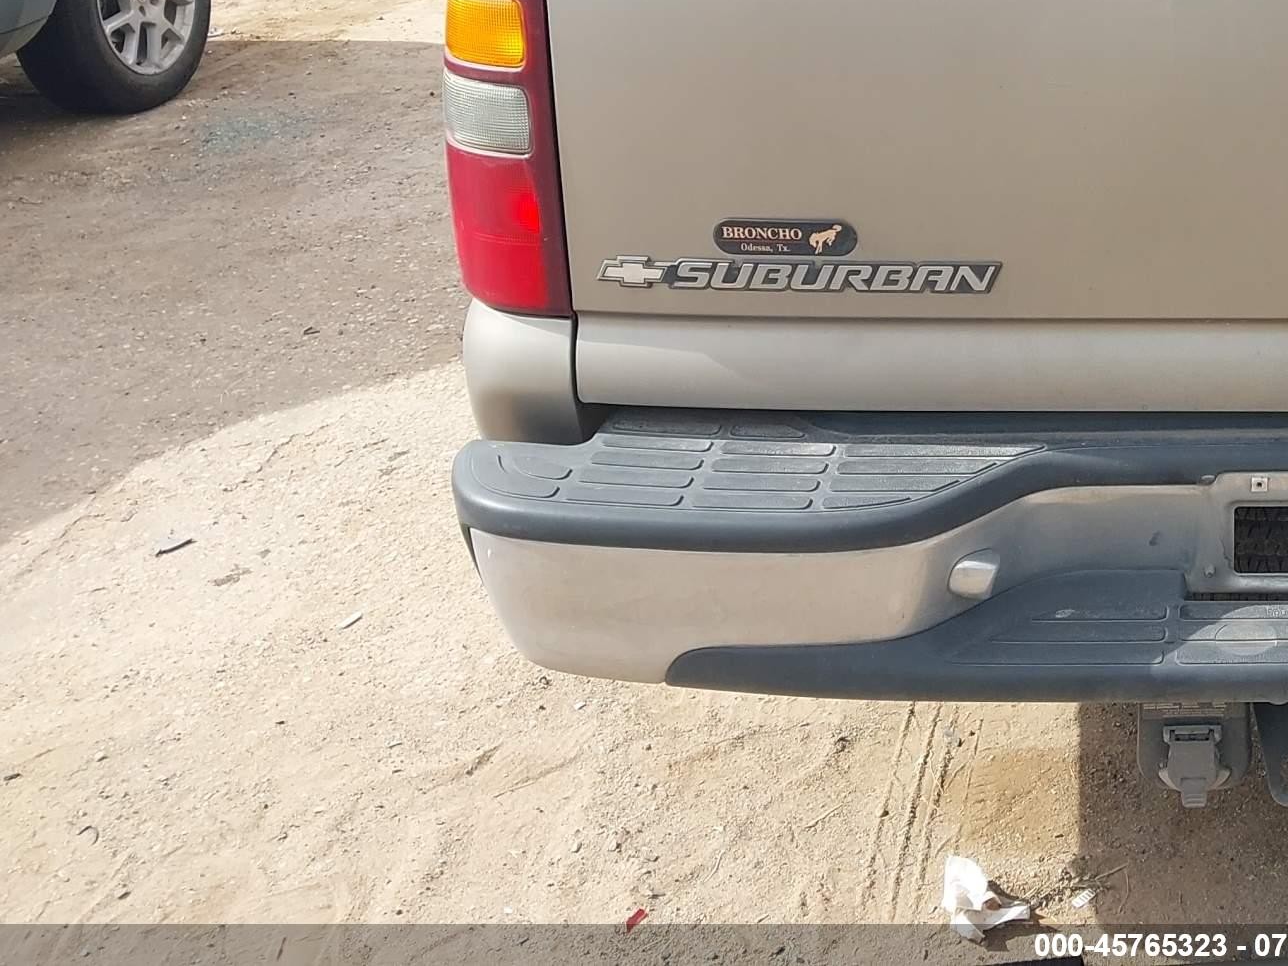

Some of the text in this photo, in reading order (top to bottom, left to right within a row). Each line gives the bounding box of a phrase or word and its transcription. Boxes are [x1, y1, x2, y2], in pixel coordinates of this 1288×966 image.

[721, 225, 803, 241] BRONCHO
[740, 242, 774, 253] Odessa,
[670, 261, 1001, 293] SUBURBAN
